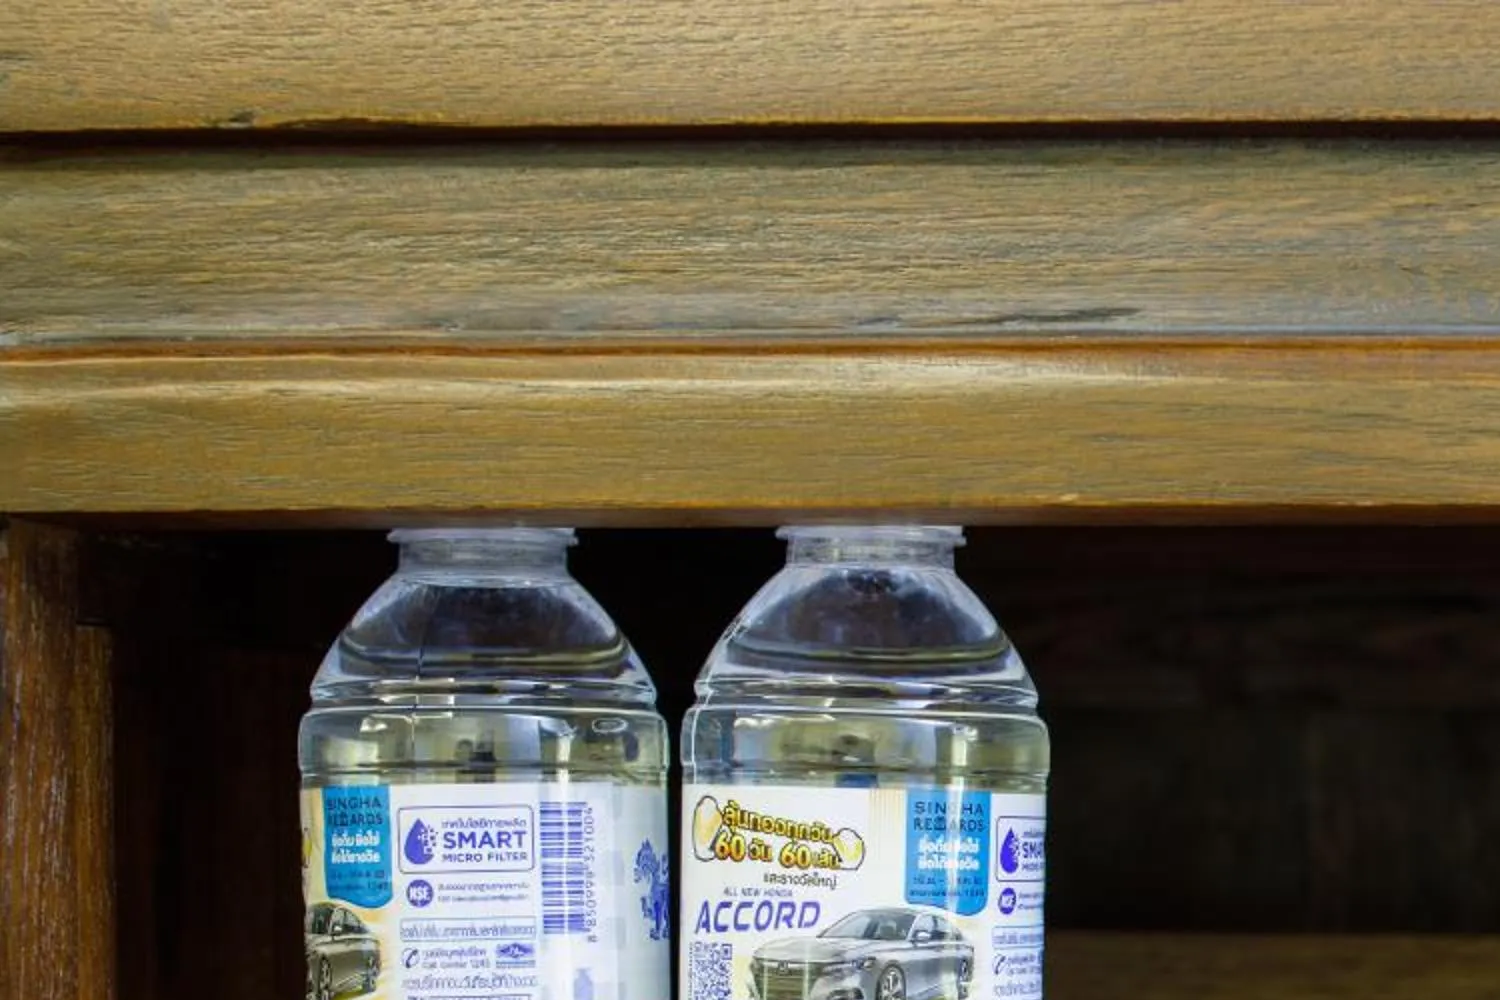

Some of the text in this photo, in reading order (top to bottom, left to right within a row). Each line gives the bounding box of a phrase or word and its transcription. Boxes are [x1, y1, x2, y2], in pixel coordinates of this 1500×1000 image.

[914, 800, 984, 815] SINHA
[442, 830, 527, 849] SMART
[441, 851, 528, 863] MICRO FILTER
[714, 829, 746, 862] 60
[778, 841, 812, 869] 60
[741, 887, 760, 896] NEW
[694, 900, 822, 934] ACCORD
